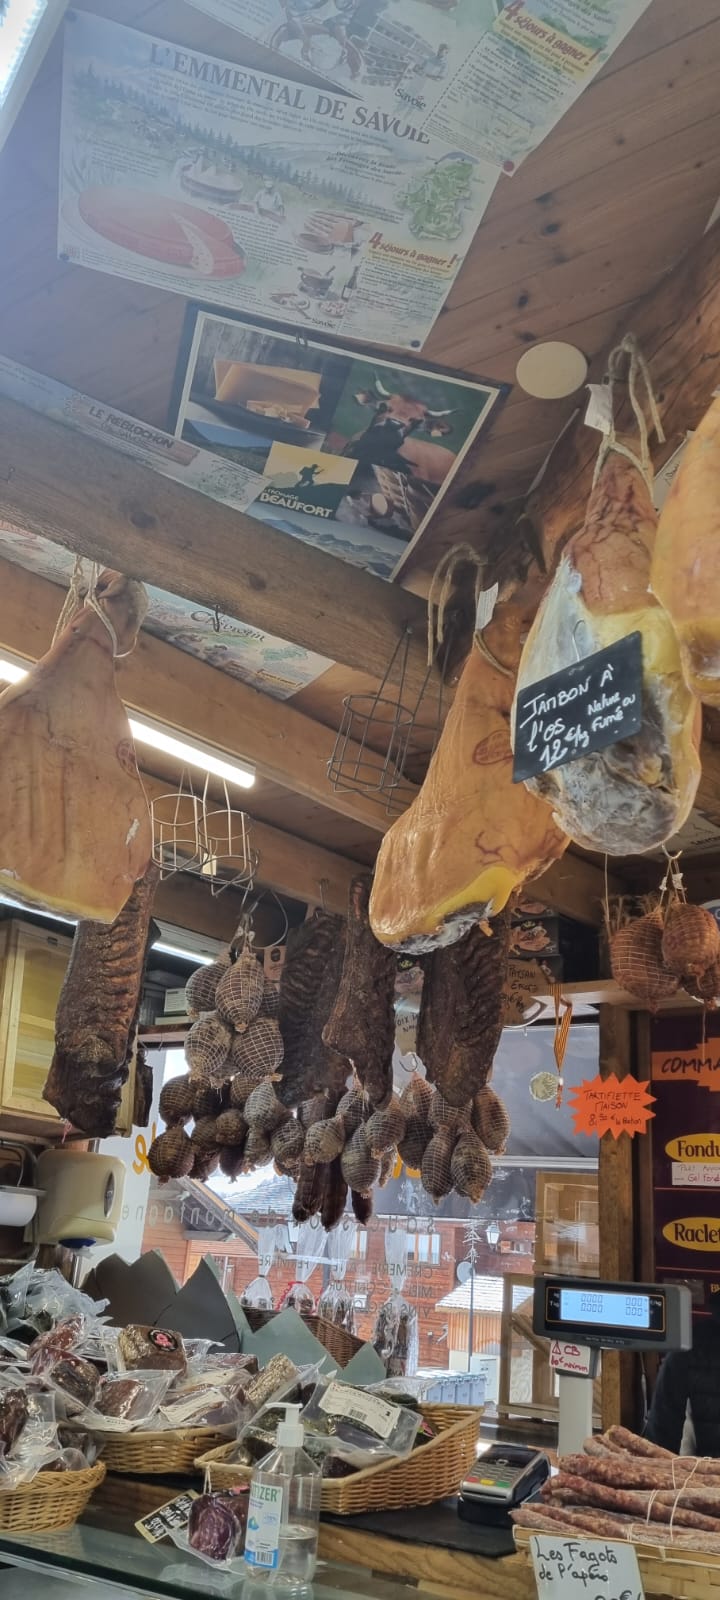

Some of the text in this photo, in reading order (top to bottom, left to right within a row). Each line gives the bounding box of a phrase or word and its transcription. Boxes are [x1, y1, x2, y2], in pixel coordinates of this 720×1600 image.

[504, 0, 526, 21] 4
[513, 14, 548, 40] séjours
[551, 39, 587, 61] gagner
[151, 43, 307, 111] L'EMMENTAL
[313, 94, 347, 121] DE
[395, 87, 427, 111] Savoie
[368, 231, 384, 250] 4
[379, 243, 409, 257] séjours
[416, 252, 447, 266] gagner
[88, 406, 106, 419] LE
[260, 491, 334, 518] BEAUFORT
[587, 692, 621, 716] Nature
[591, 705, 624, 734] Fumé
[539, 738, 569, 774] 12
[595, 1101, 629, 1113] MAISON
[564, 1344, 581, 1357] CB
[534, 1536, 618, 1567] Les Fagots
[538, 1563, 554, 1582] de
